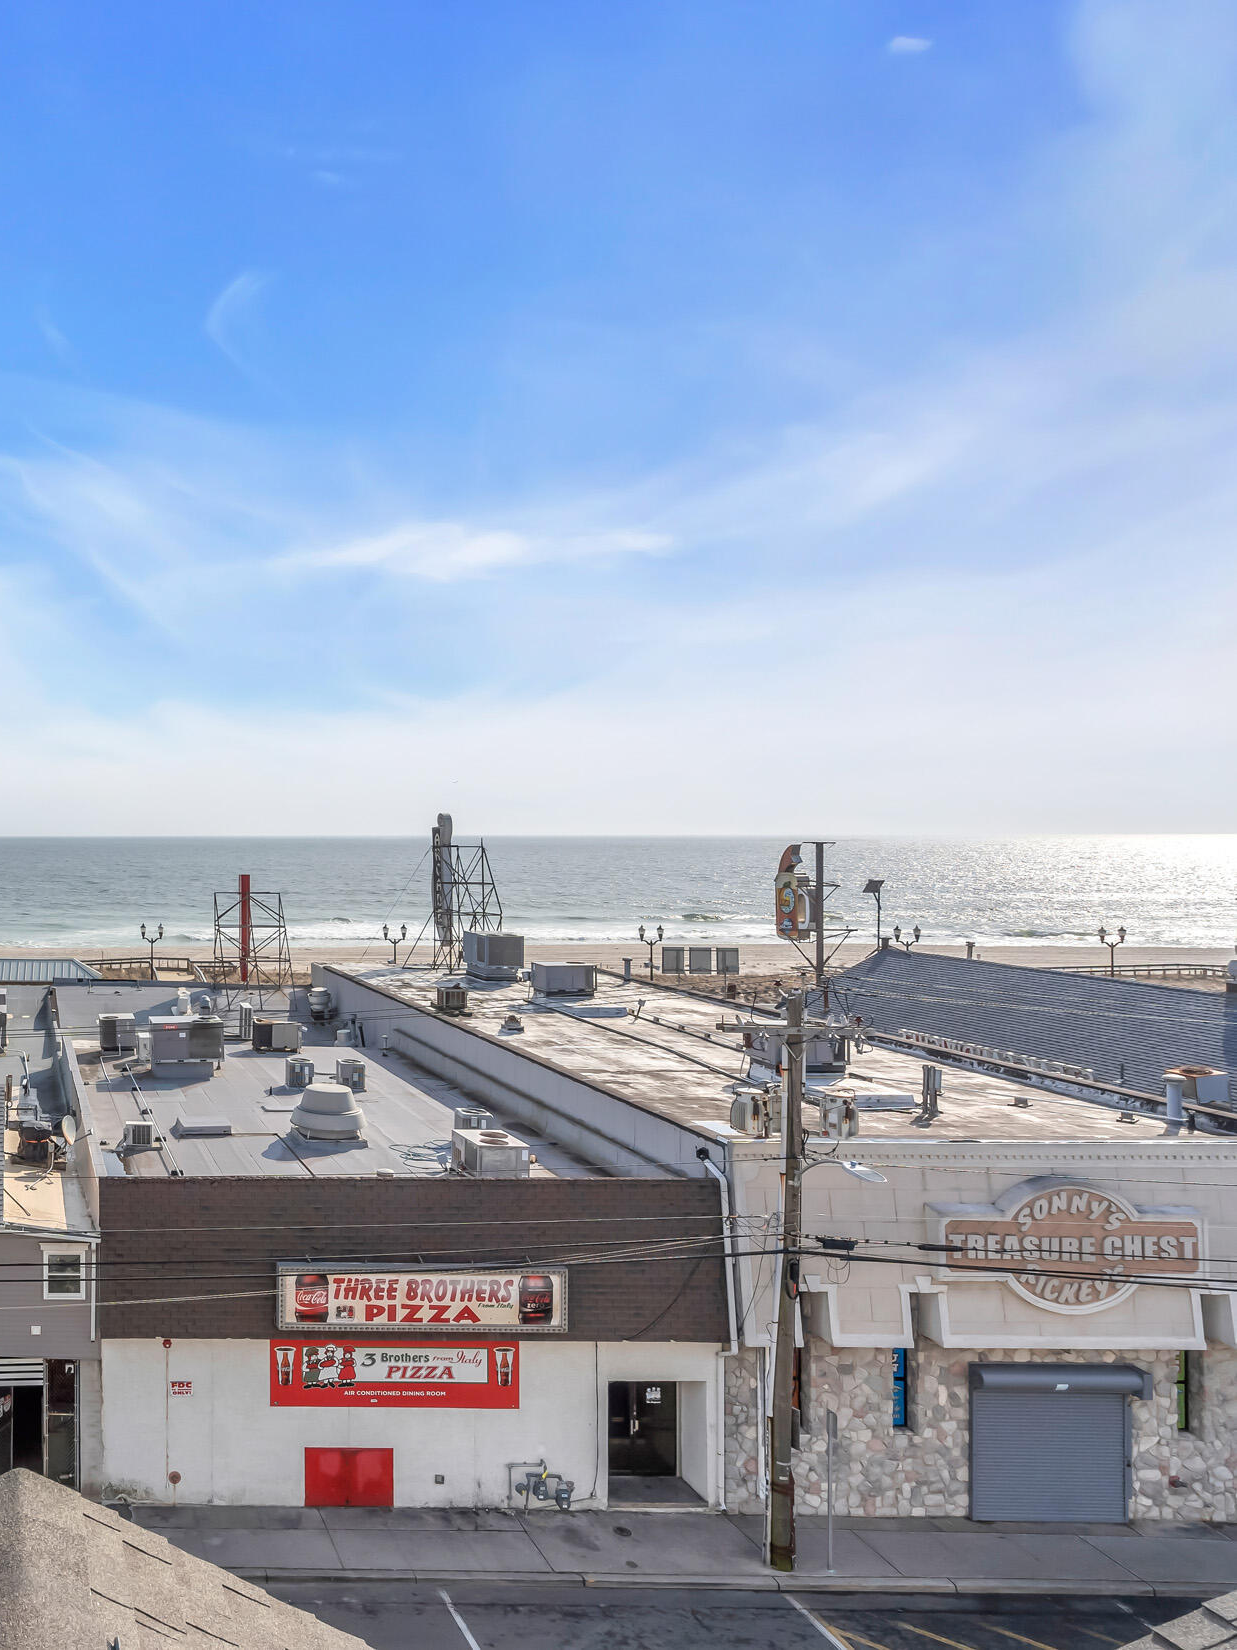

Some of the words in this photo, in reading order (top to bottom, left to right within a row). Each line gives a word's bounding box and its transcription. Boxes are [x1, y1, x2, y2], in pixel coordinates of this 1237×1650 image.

[1018, 1191, 1127, 1232] SONNY'S
[948, 1233, 1097, 1263] TREASURE
[1103, 1234, 1198, 1262] CHEST
[332, 1277, 400, 1303] THREE
[405, 1278, 515, 1304] BROTHERS
[364, 1303, 482, 1324] PIZZA
[361, 1352, 377, 1367] 3
[380, 1352, 430, 1364] Brothers
[450, 1349, 483, 1368] Italy
[384, 1365, 456, 1380] PIZZA
